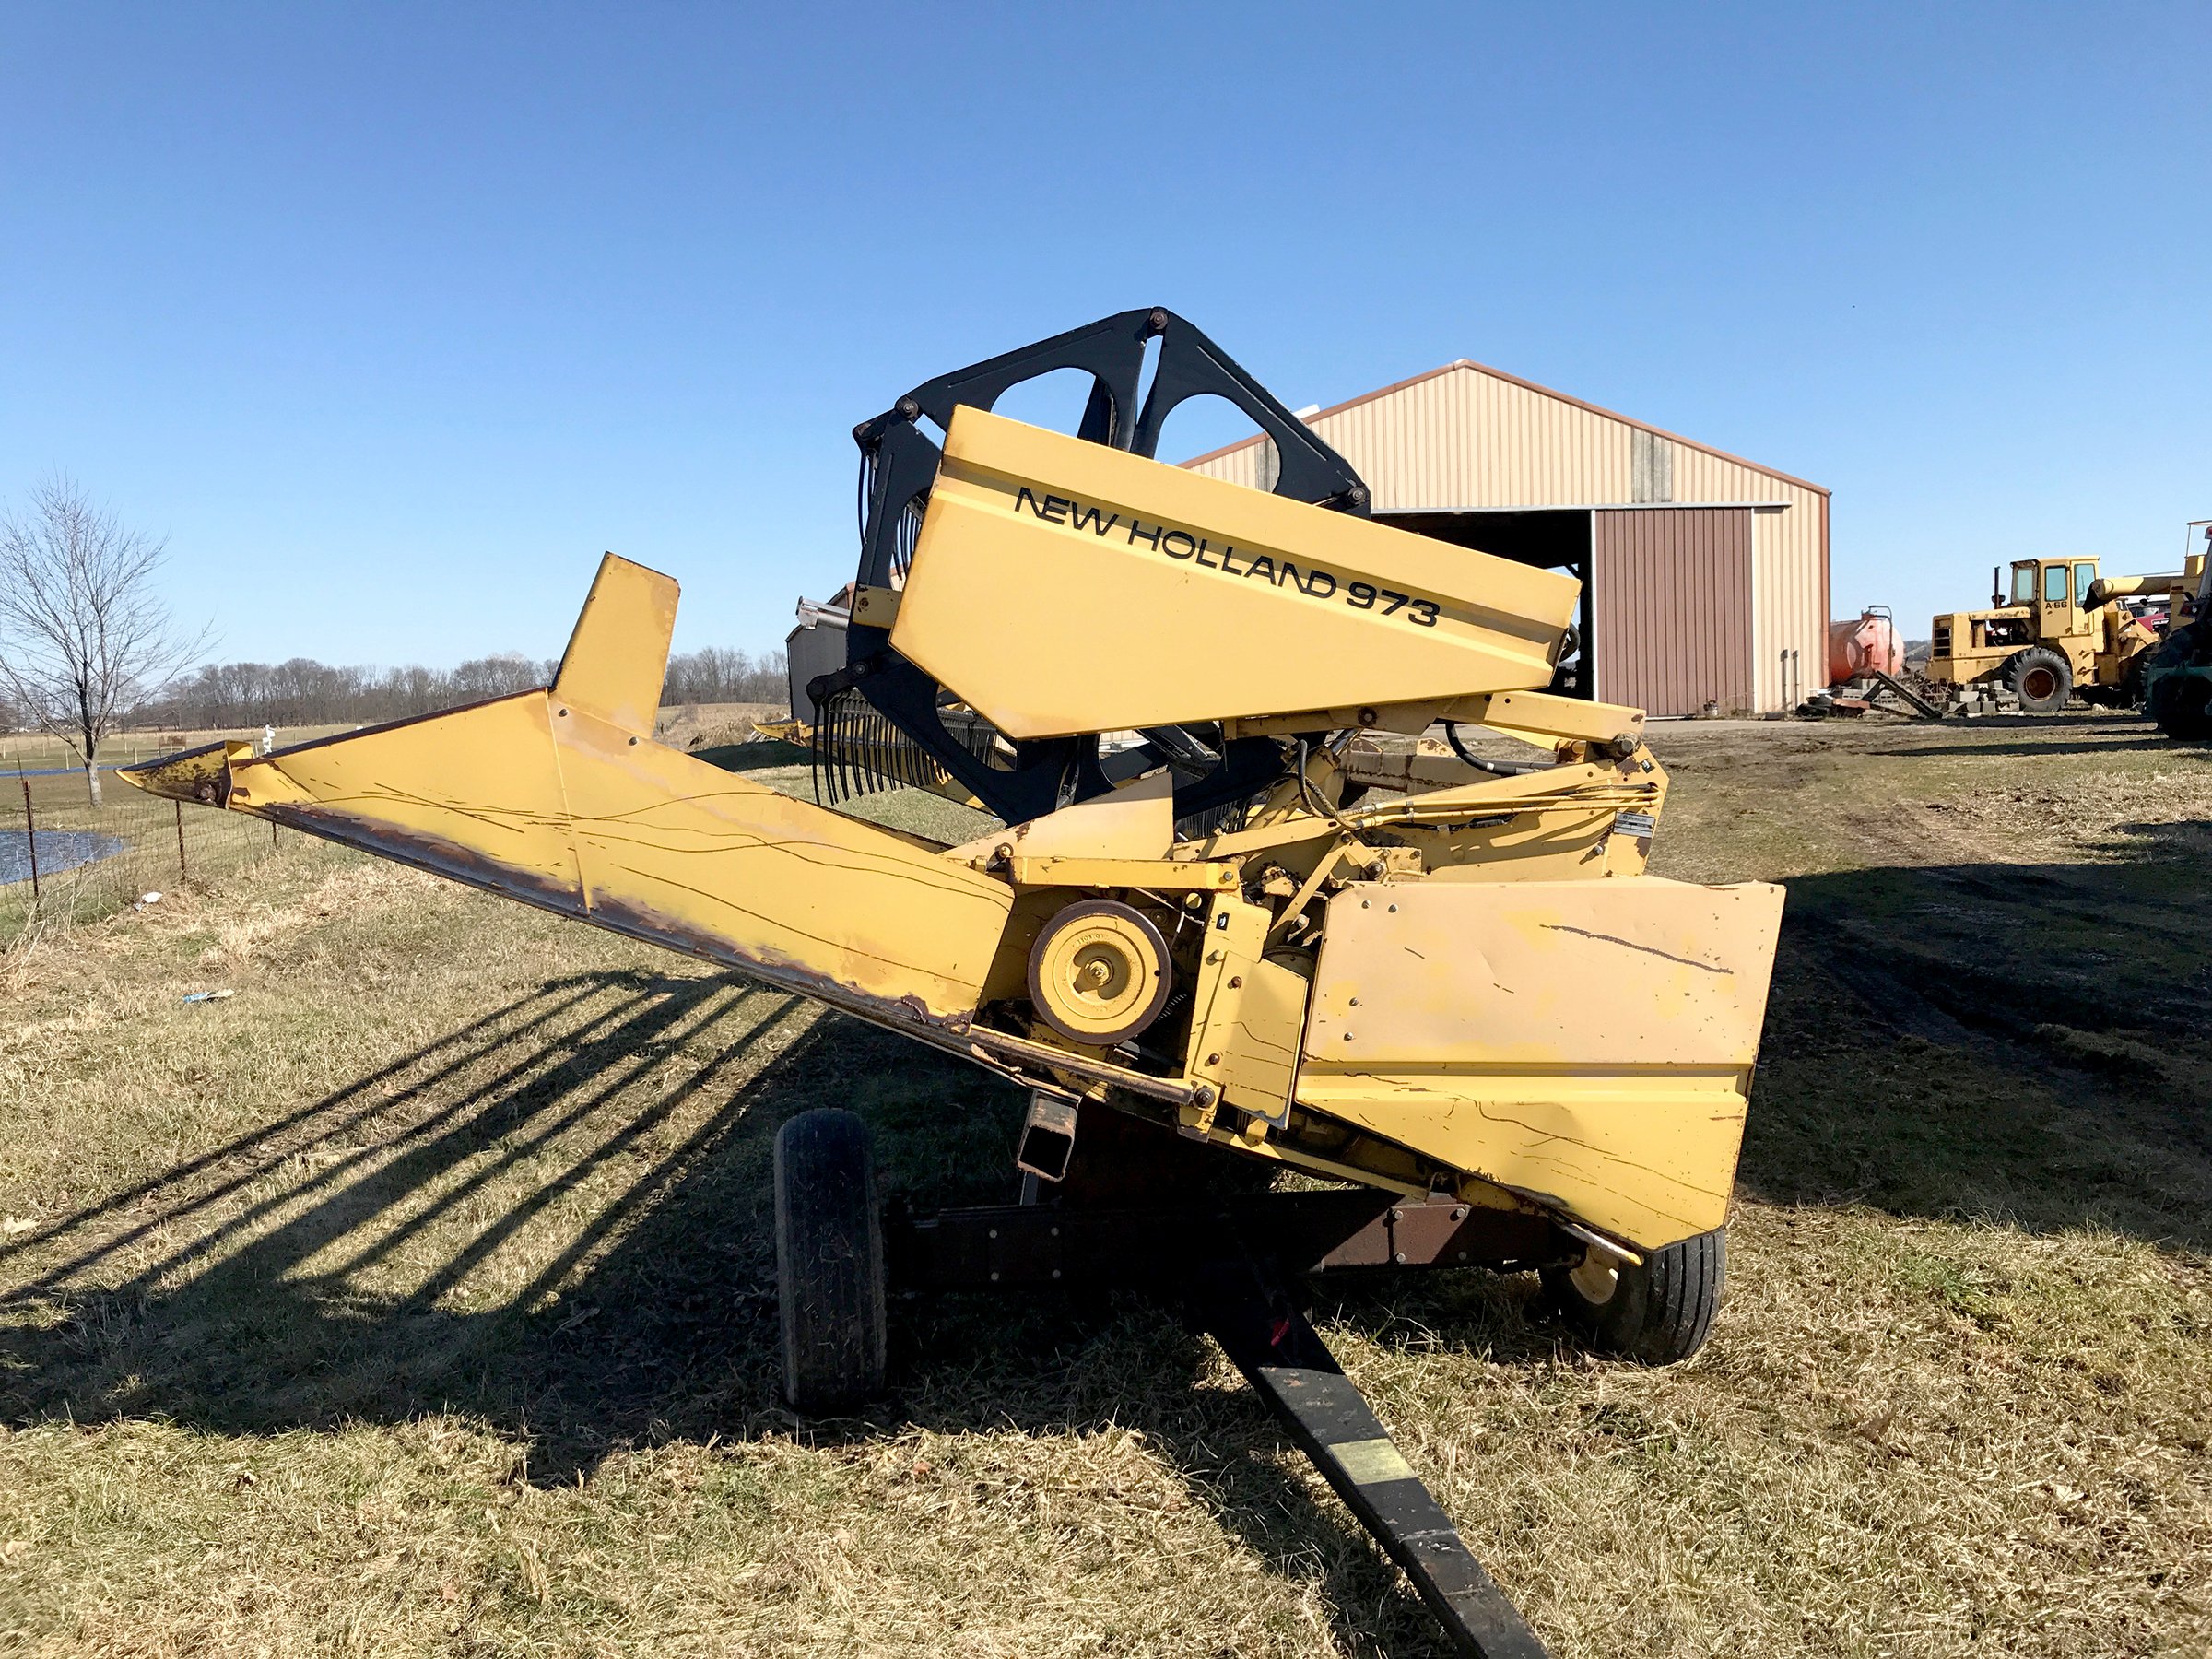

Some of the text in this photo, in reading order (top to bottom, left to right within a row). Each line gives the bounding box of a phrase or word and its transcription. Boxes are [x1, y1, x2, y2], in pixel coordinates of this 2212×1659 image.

[1015, 487, 1440, 627] NEW HOLLAND 973
